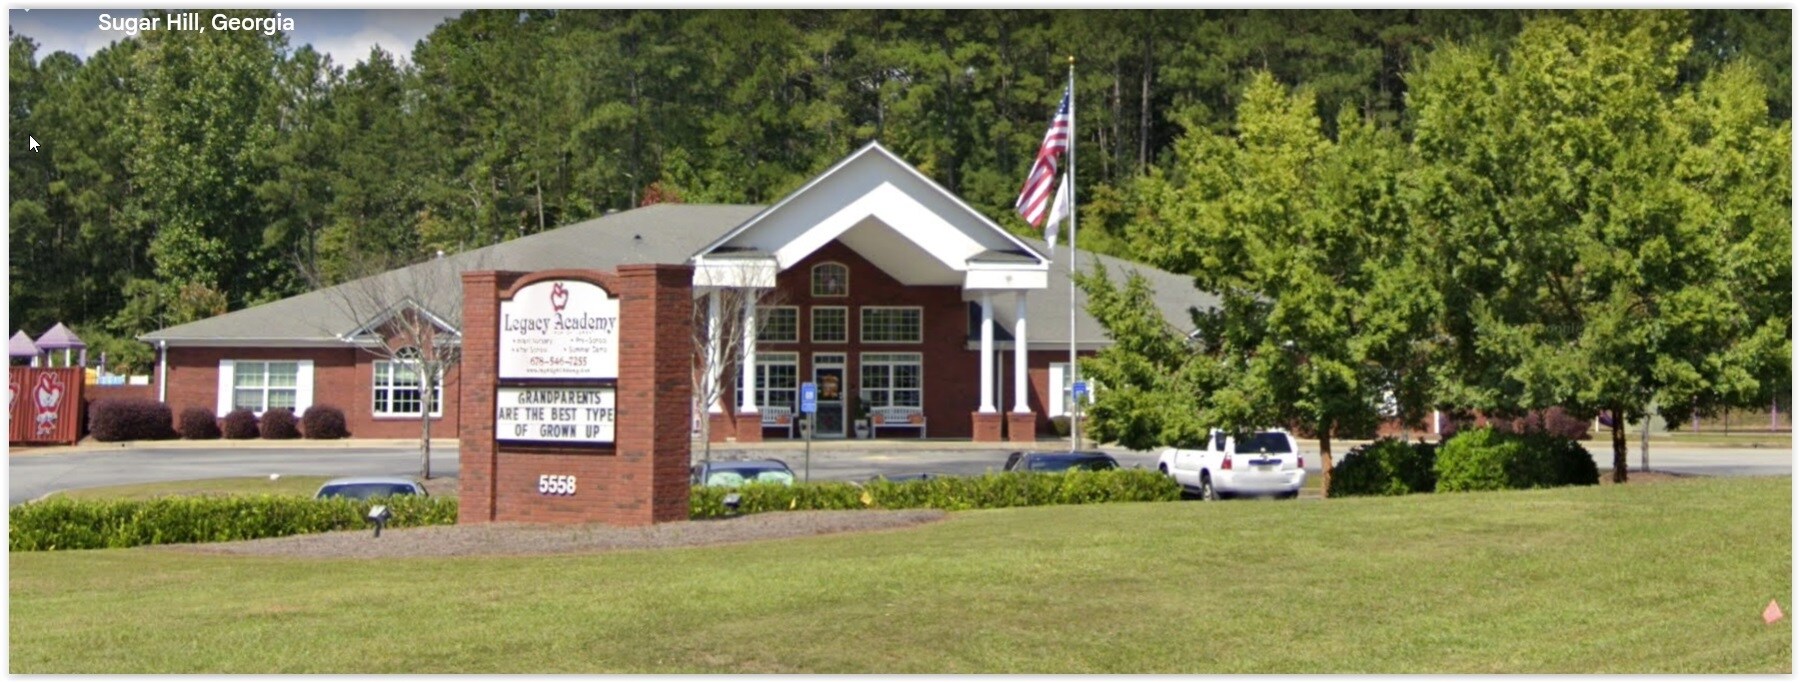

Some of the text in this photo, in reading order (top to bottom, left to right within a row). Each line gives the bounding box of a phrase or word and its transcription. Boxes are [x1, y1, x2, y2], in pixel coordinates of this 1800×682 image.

[504, 312, 617, 335] Legacy Academy
[530, 356, 588, 366] 678-546-7255
[518, 390, 602, 405] GRANDPARENTS
[499, 407, 614, 422] ARE THE BEST TYPE
[514, 424, 600, 438] OF GROWN UP
[539, 475, 577, 495] 5558
